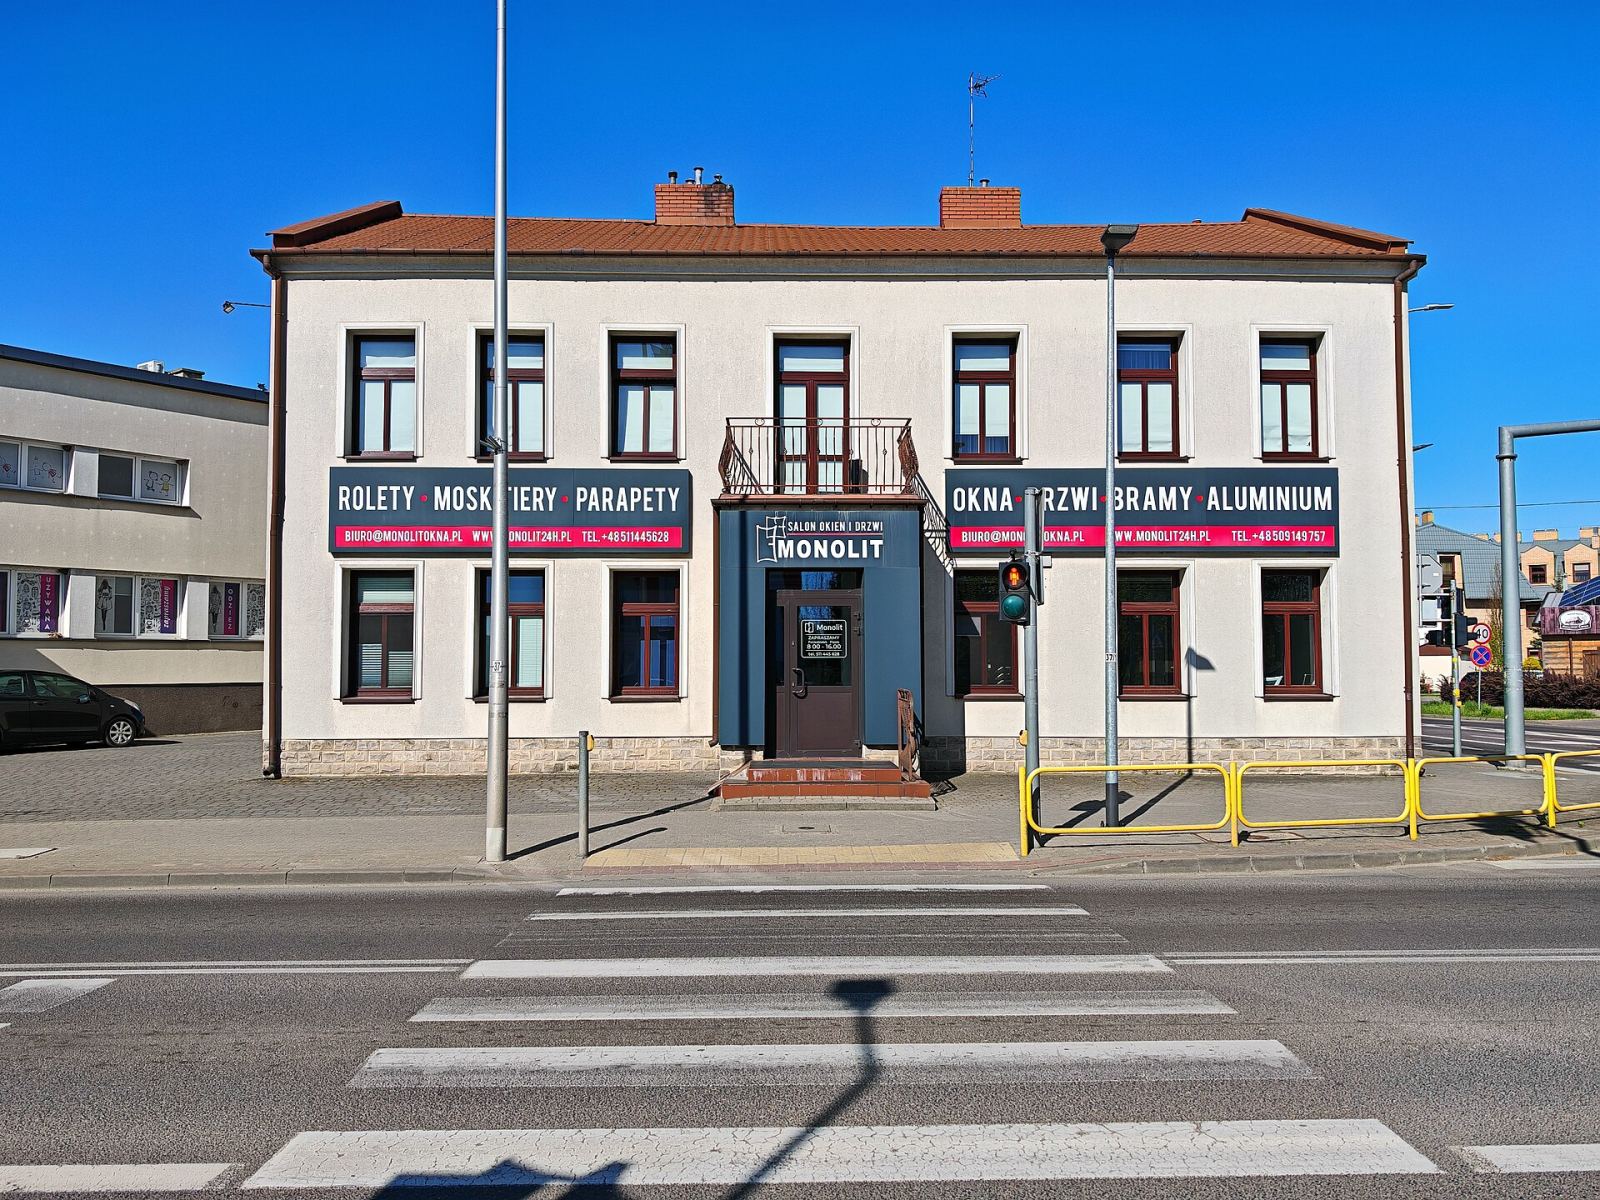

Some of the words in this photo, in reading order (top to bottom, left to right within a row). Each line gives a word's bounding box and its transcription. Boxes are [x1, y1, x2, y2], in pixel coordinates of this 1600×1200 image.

[339, 486, 415, 511] ROLETY
[434, 486, 557, 511] MOSKIERY
[576, 487, 680, 512] PARAPETY
[953, 487, 1014, 512] OKNA
[1043, 487, 1098, 511] RZWI
[1114, 486, 1193, 511] BRAMY
[1207, 486, 1332, 511] ALUMINIUM
[788, 522, 816, 532] SALON
[820, 522, 845, 532] OKIEN
[849, 522, 852, 532] I
[855, 522, 883, 532] DRZWI
[345, 530, 463, 543] BIURO@MONOLITOKNA.PL
[1115, 531, 1211, 542] WW.MONOLIT24H.PL
[778, 540, 884, 559] MONOLIT
[1476, 629, 1488, 638] 40
[494, 661, 500, 671] 37
